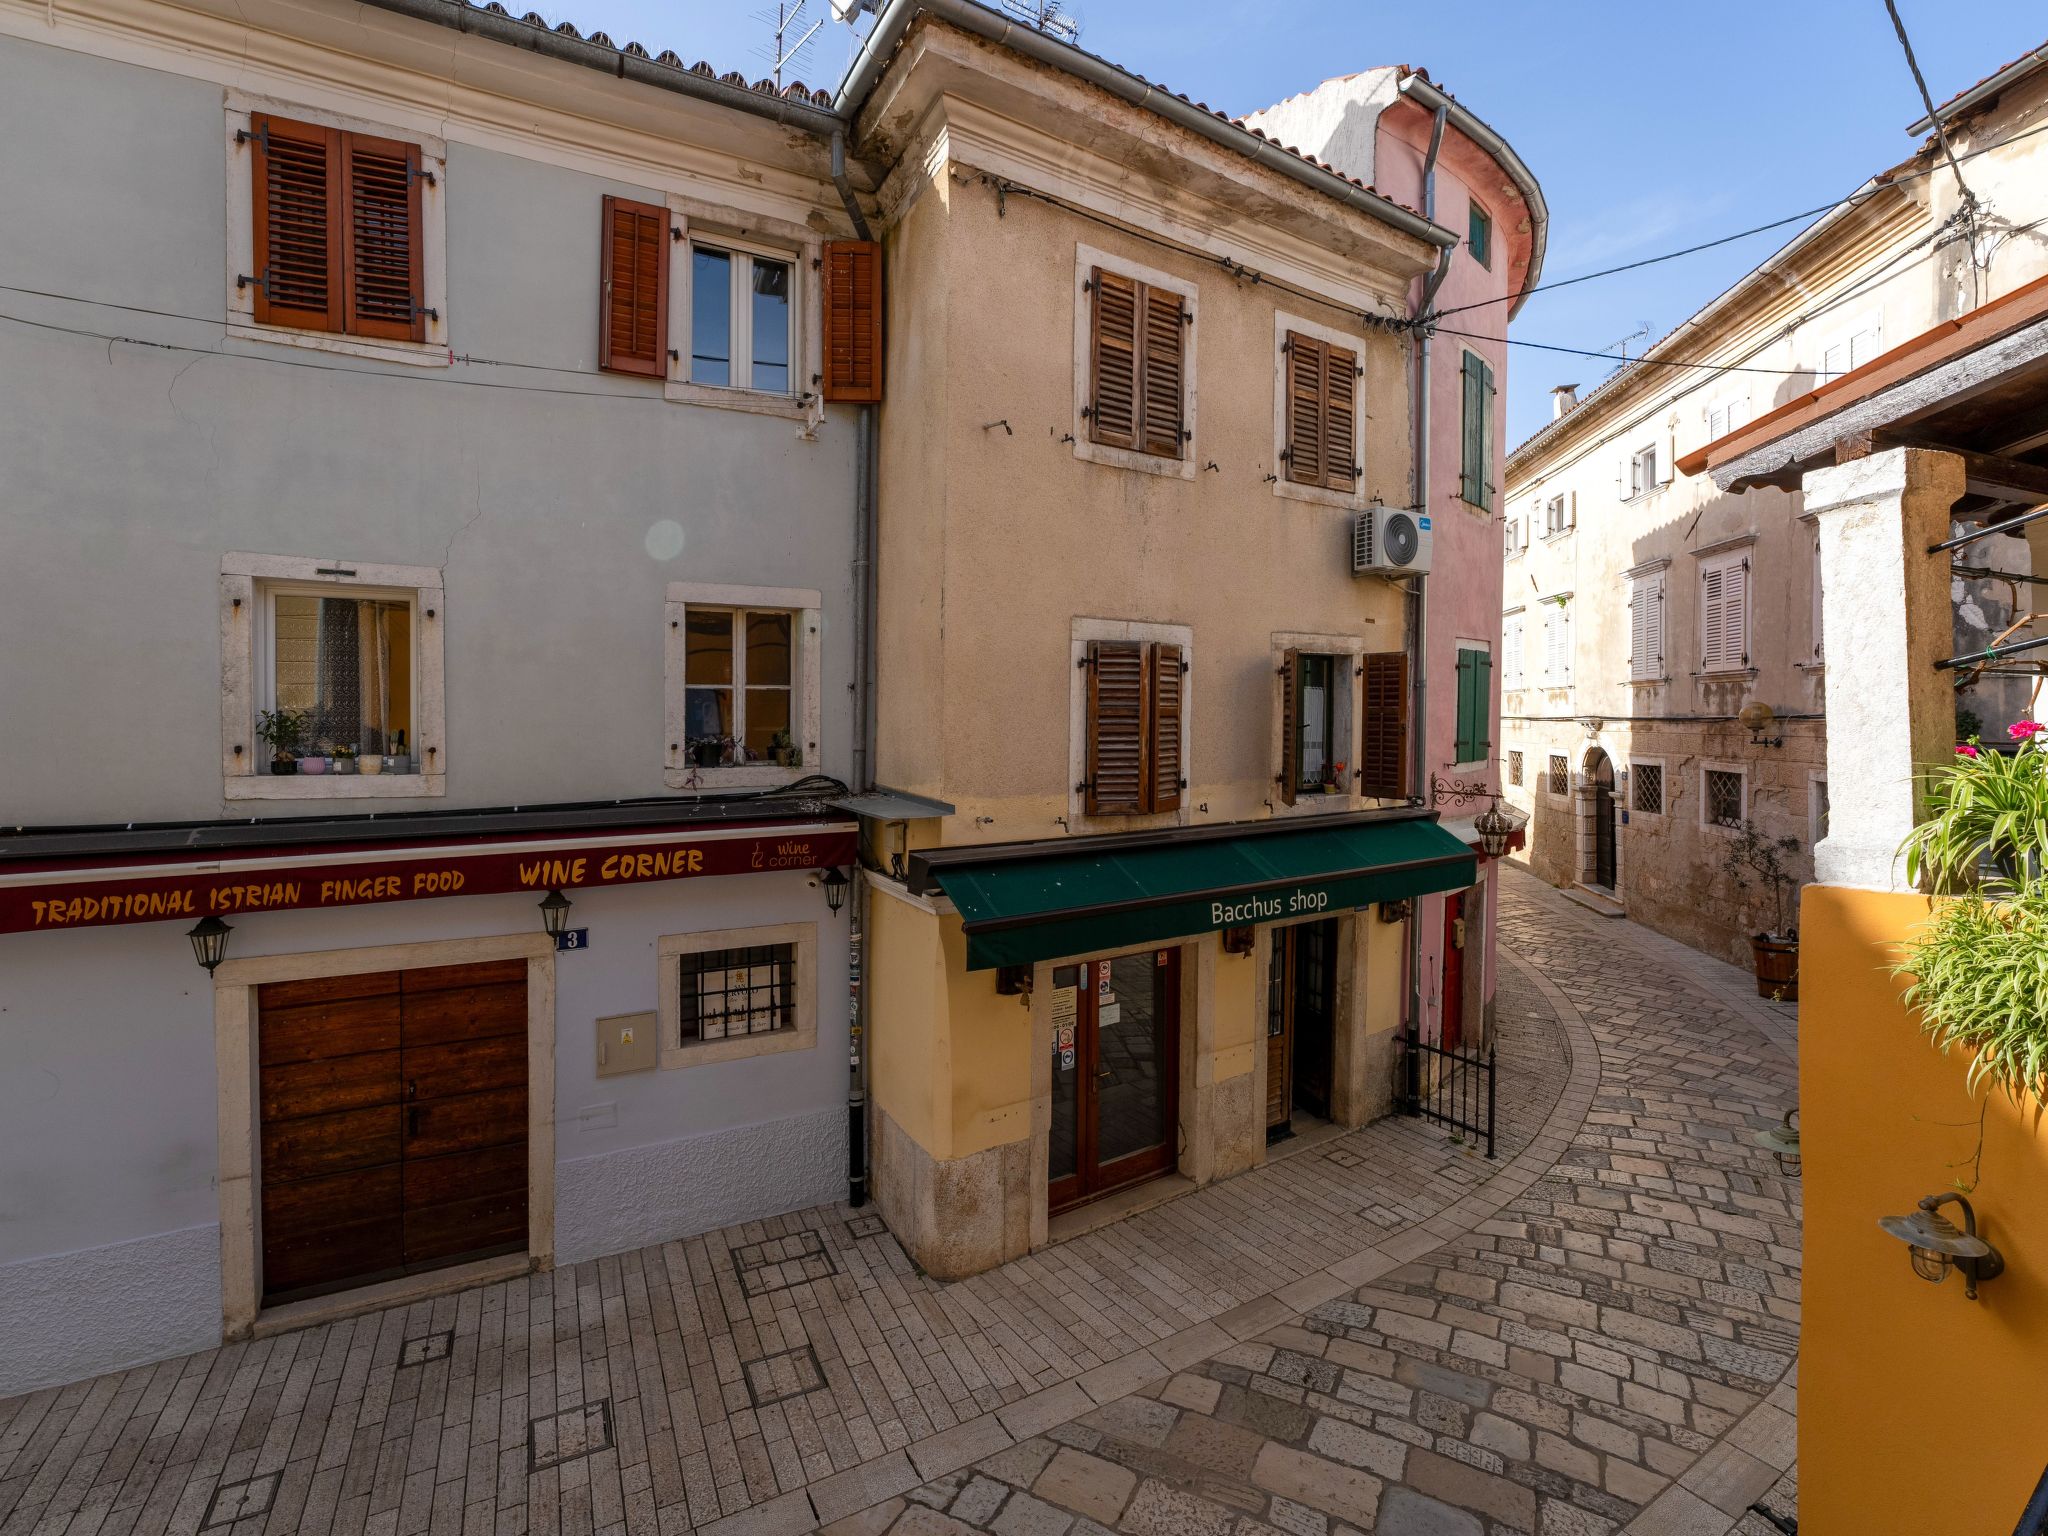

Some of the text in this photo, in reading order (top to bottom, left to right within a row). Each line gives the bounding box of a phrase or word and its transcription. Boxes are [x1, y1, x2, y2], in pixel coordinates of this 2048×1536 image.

[768, 855, 817, 867] corner
[777, 840, 810, 856] wine
[519, 849, 704, 886] WINE CORNER
[32, 870, 465, 926] TRADITIONAL ISTRIAN FINGER FOOD
[1211, 889, 1328, 925] Bacchus shop
[567, 931, 578, 948] 3
